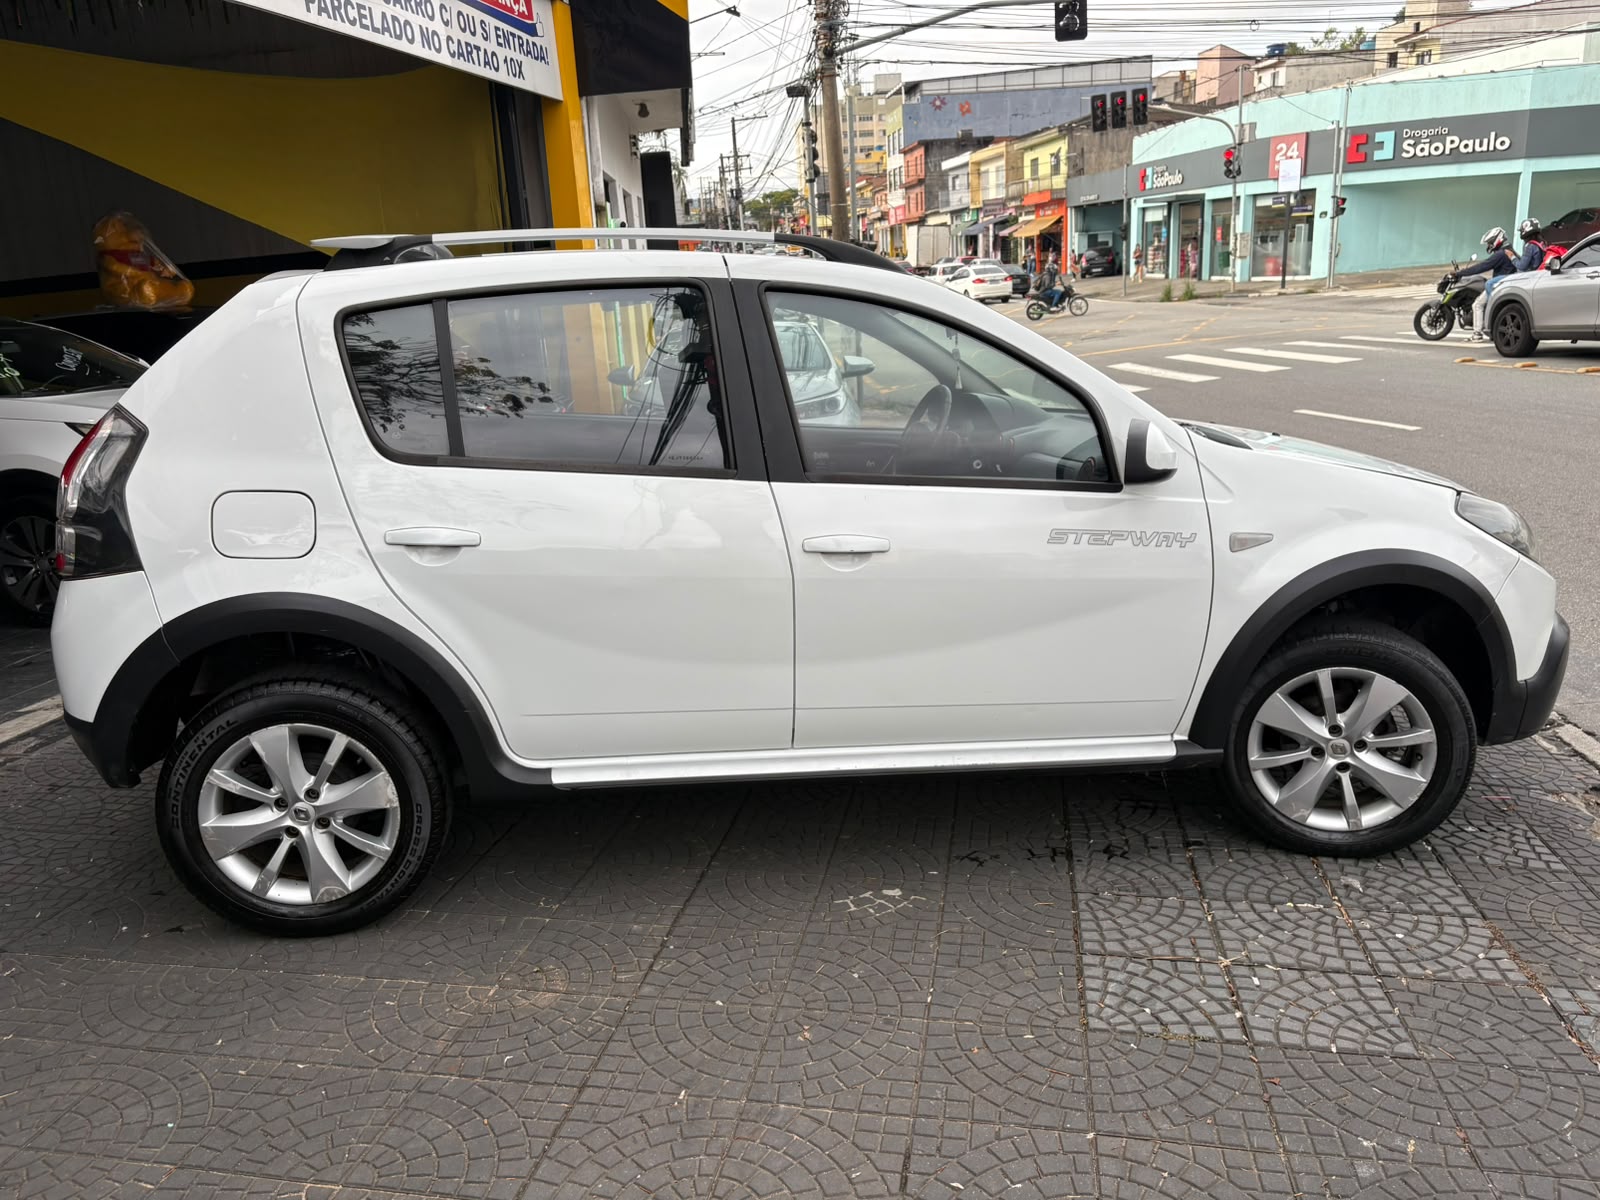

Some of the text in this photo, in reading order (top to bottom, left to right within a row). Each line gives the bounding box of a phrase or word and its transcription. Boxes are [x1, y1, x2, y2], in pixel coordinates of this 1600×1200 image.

[418, 24, 442, 54] NO
[504, 56, 526, 81] 10X
[439, 3, 453, 29] C/
[456, 10, 477, 37] OU
[480, 19, 491, 43] S/
[494, 25, 550, 67] ENTRADA!
[1275, 141, 1300, 162] 24
[1403, 126, 1449, 139] Drogaria
[1047, 528, 1197, 548] STEPWAY
[171, 720, 240, 829] CONTINENTAL
